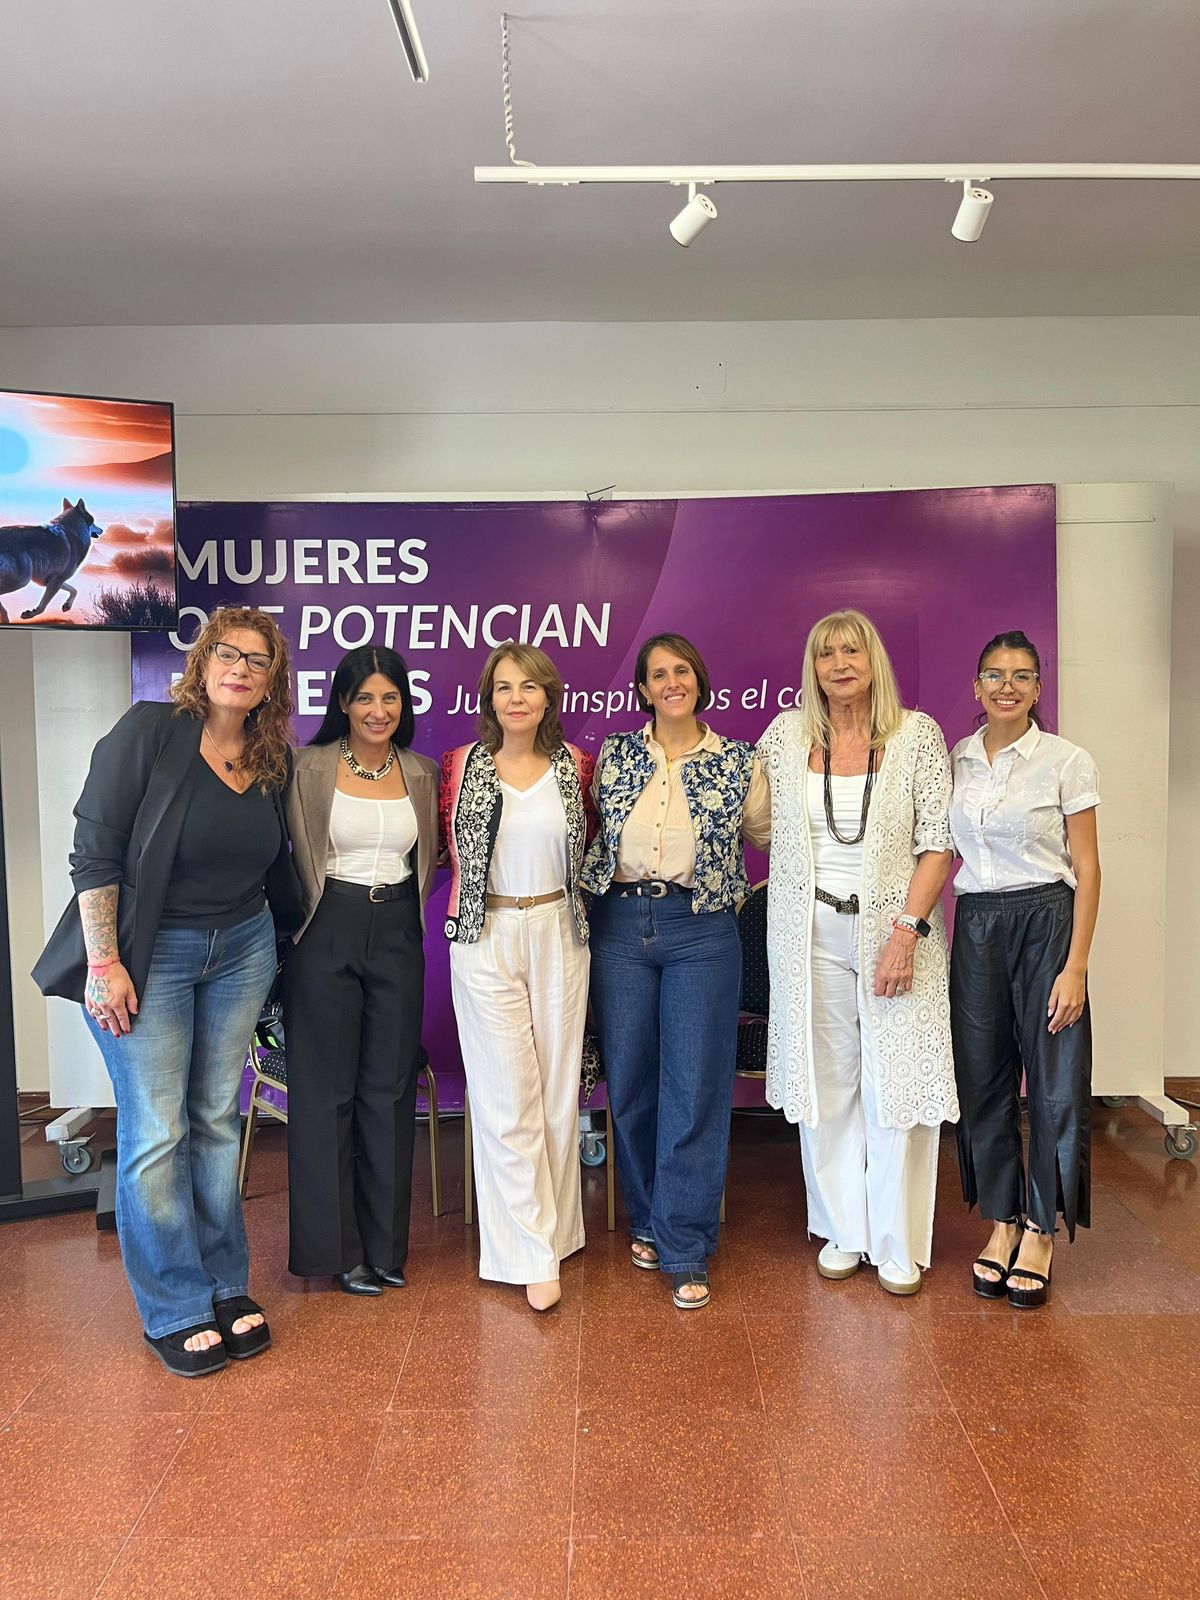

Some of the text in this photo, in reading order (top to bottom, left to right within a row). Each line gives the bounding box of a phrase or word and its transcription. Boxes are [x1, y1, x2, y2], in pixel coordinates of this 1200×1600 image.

[177, 538, 429, 585] MUJERES
[298, 602, 611, 650] POTENCIAN
[741, 679, 768, 710] el
